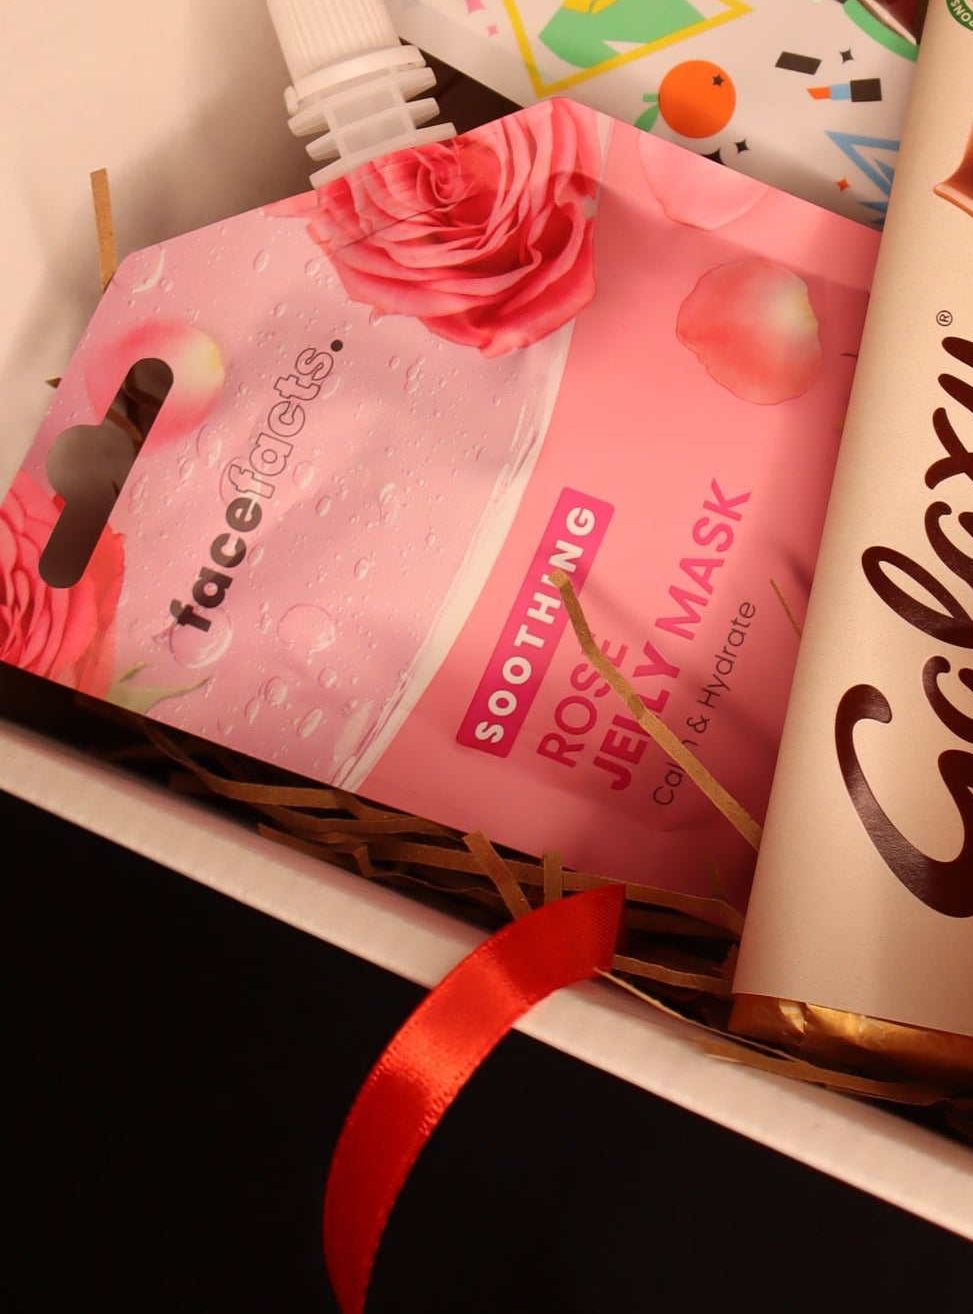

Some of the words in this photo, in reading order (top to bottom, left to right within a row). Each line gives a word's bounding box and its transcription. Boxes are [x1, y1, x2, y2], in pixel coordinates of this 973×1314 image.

[653, 476, 753, 642] MASK
[696, 600, 757, 710] Hydrate
[686, 714, 711, 735] &
